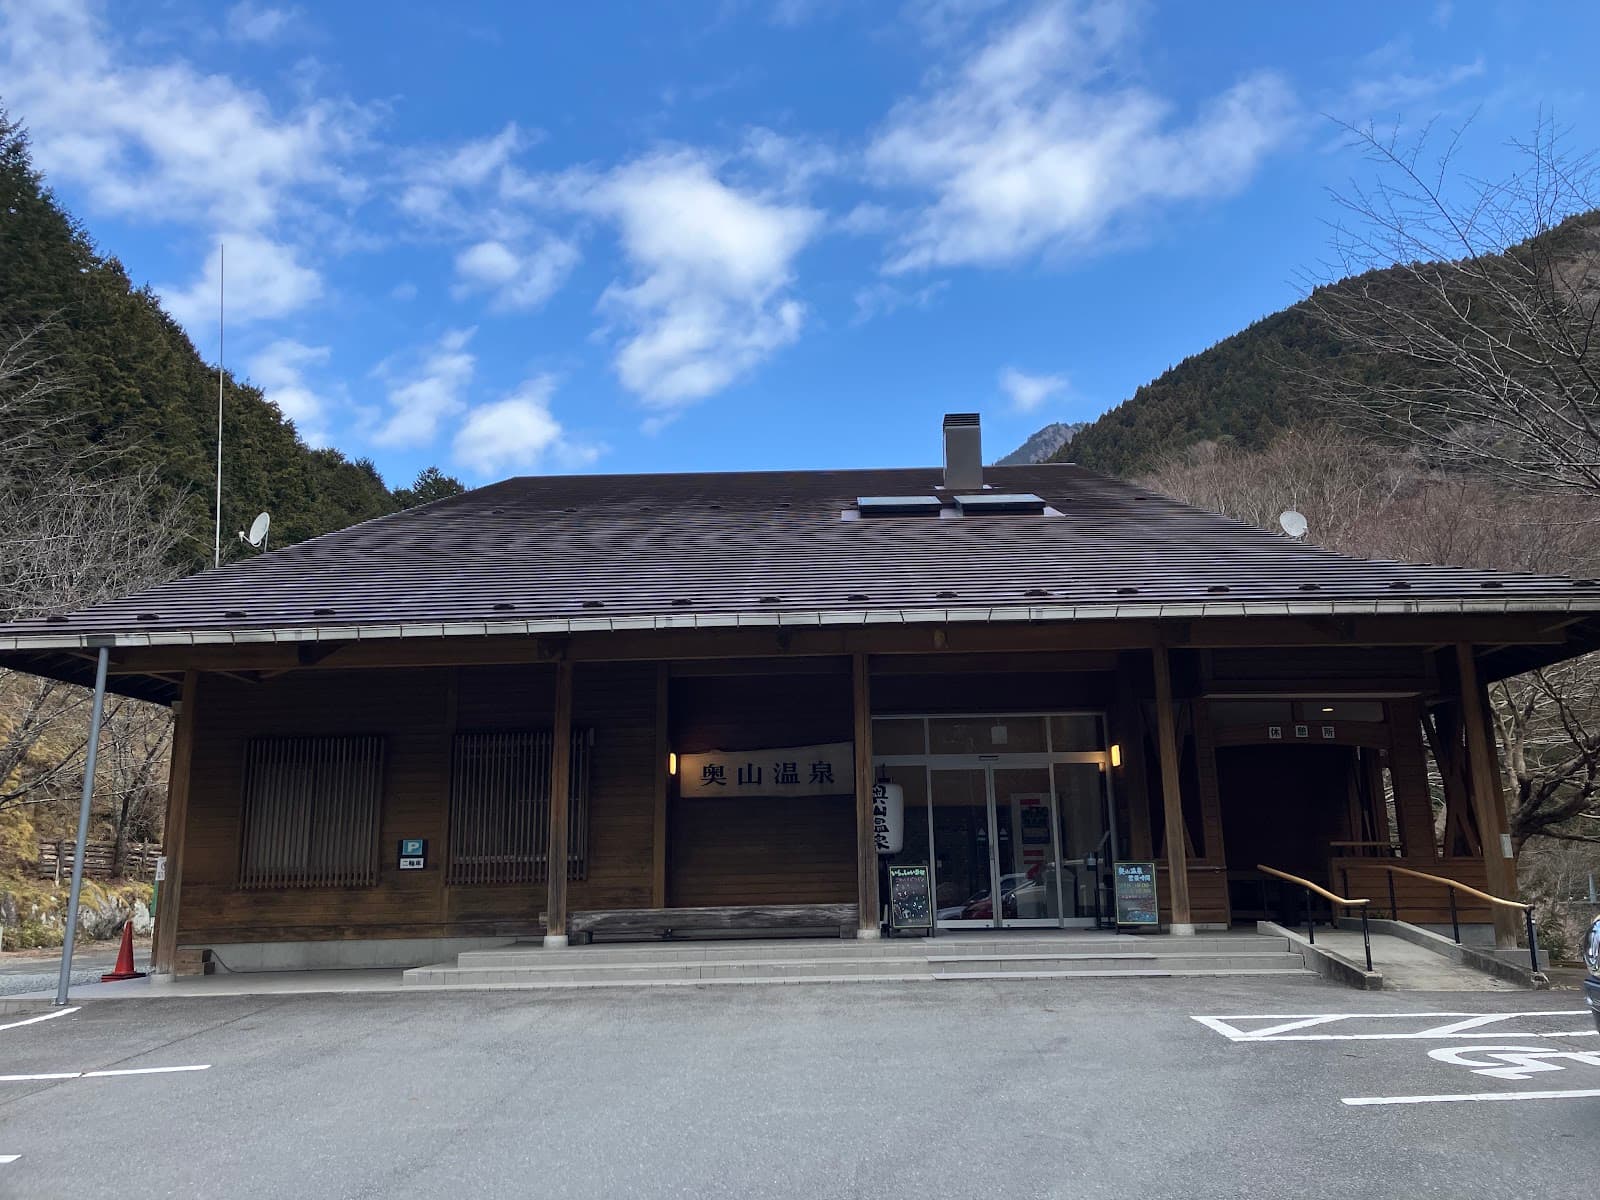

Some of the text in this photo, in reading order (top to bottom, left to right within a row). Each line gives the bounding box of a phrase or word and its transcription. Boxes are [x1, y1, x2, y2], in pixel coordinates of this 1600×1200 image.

[1270, 726, 1334, 738] 休憩所
[700, 761, 835, 786] 奥山温泉
[407, 842, 420, 852] P
